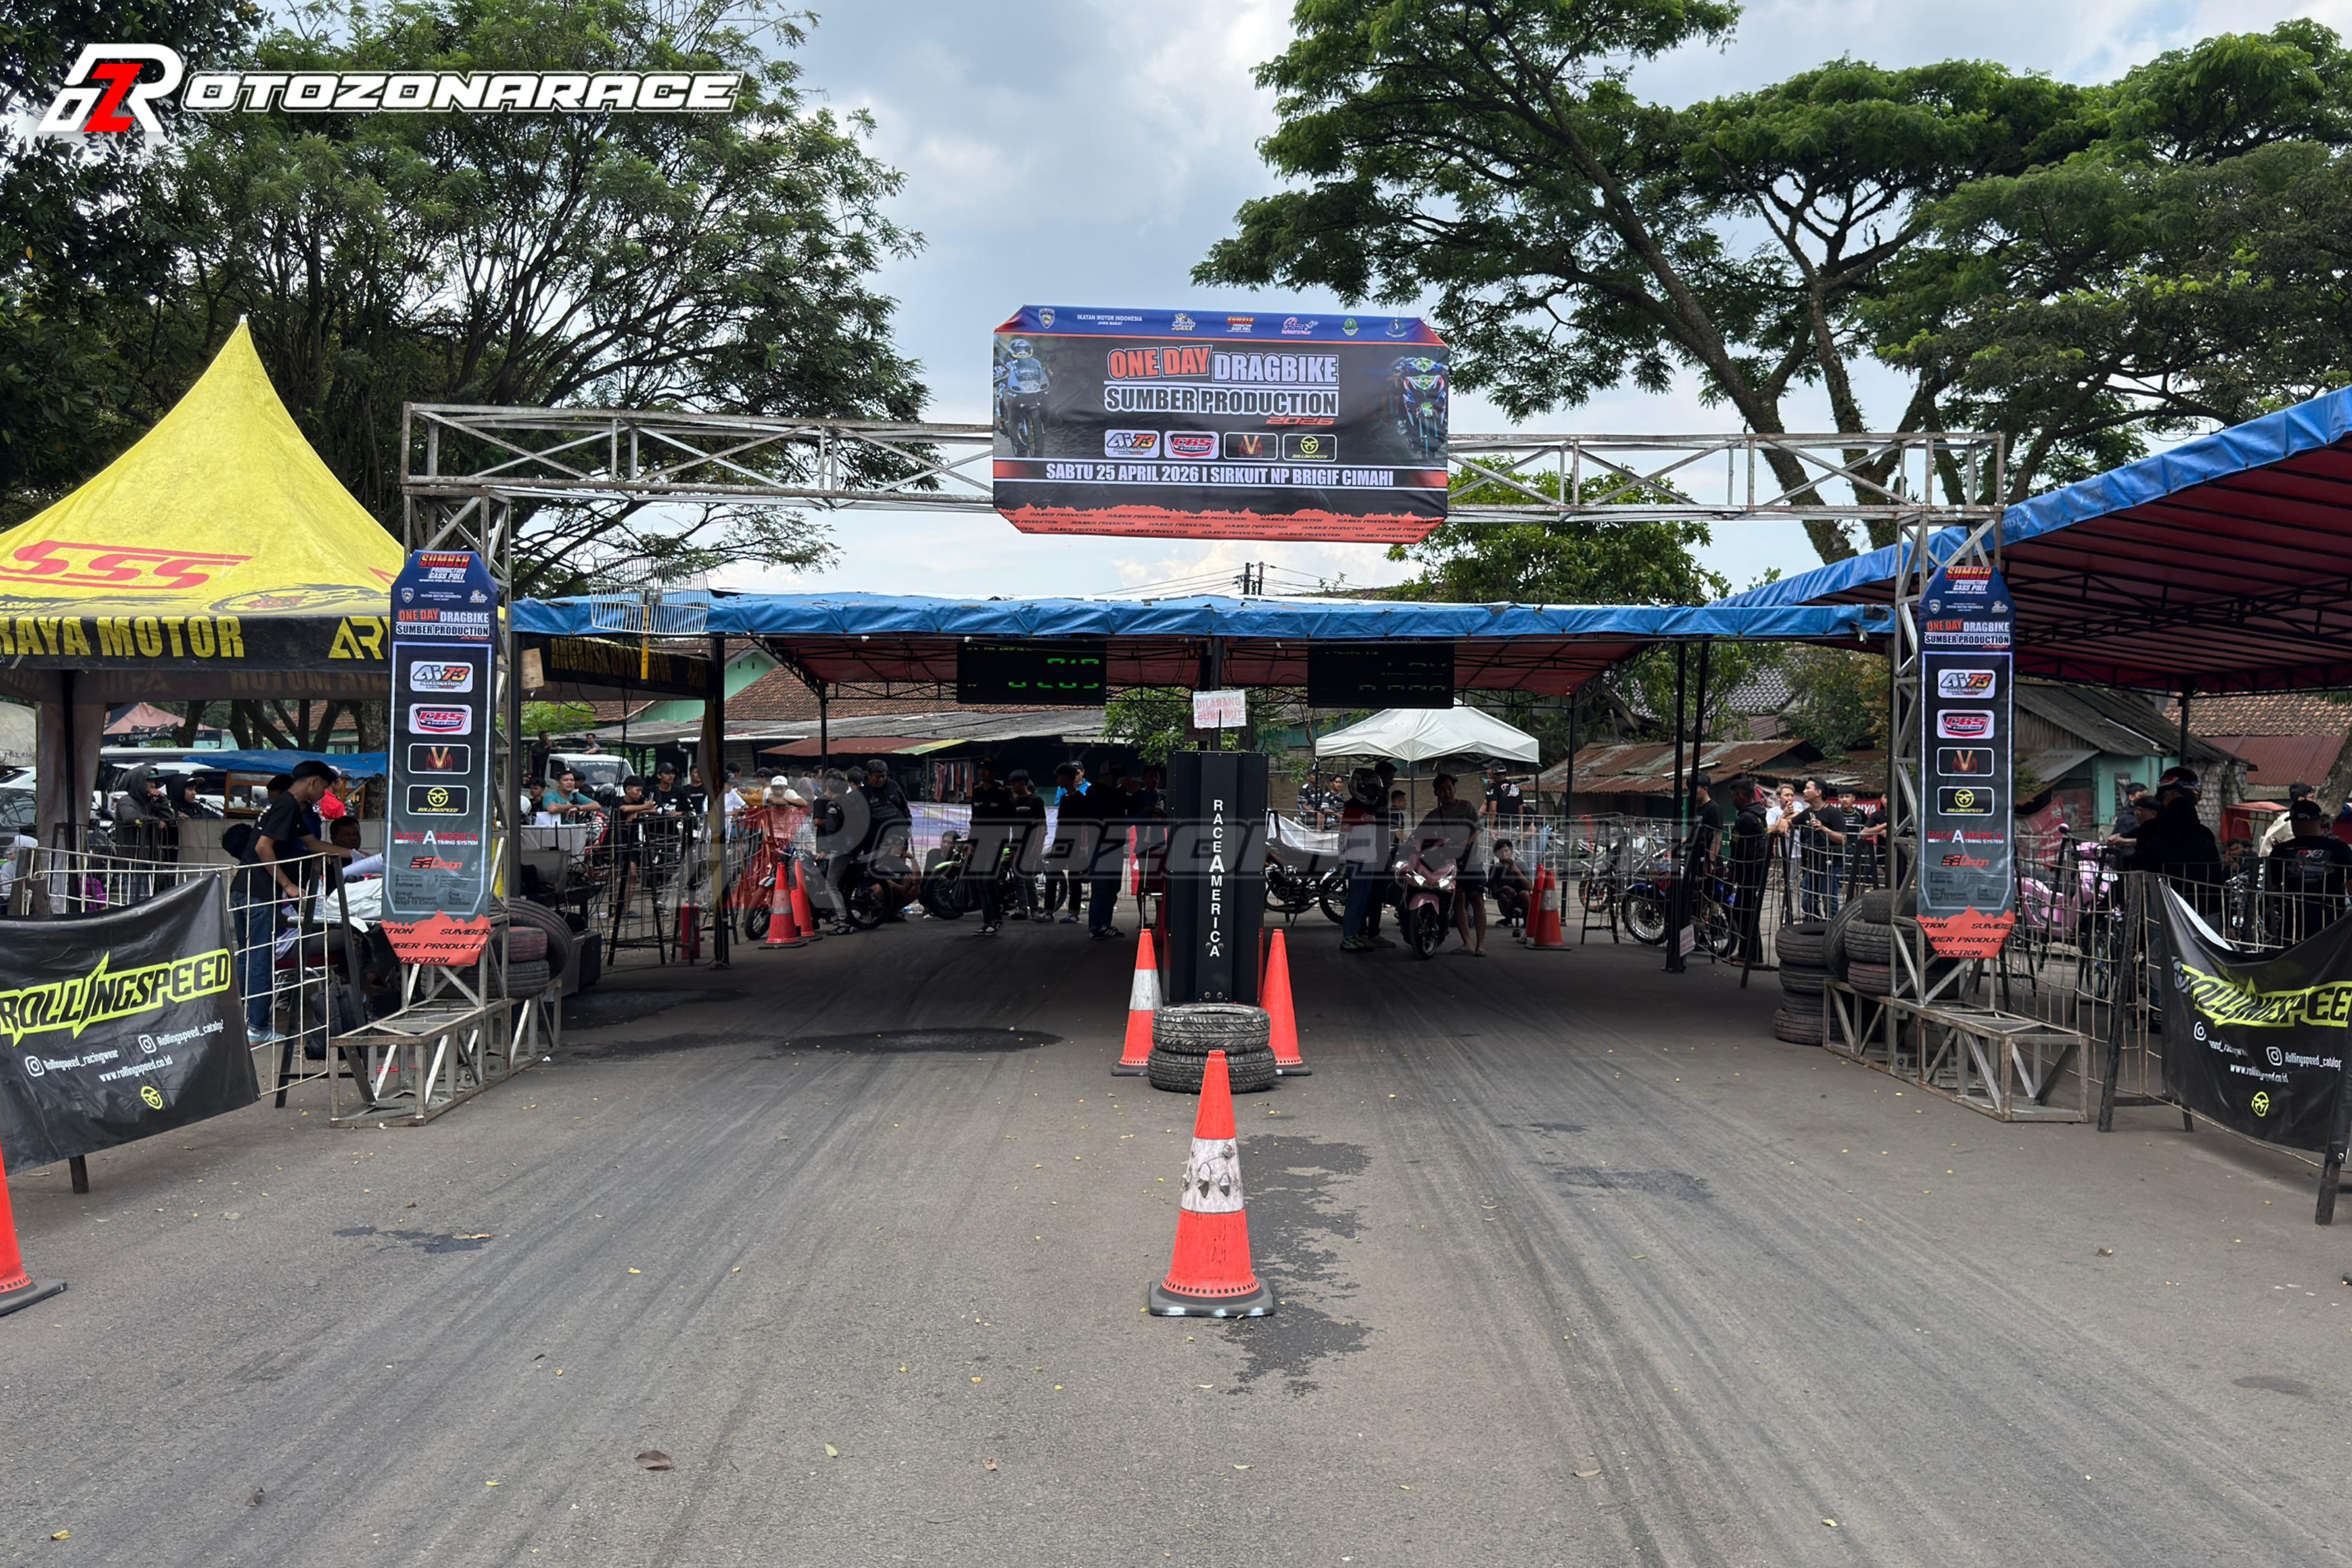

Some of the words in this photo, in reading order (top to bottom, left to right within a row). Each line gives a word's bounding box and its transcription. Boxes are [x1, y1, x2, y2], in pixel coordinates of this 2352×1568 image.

[1108, 348, 1160, 380] ONE
[1162, 346, 1211, 377] DAY
[1213, 353, 1339, 384] DRAGBIKE
[1104, 386, 1198, 412] SUMBER
[1199, 388, 1339, 416] PRODUCTION
[1266, 417, 1335, 425] 2026
[1046, 463, 1093, 480] SABTU
[1096, 464, 1115, 481] 25
[1119, 465, 1158, 482] APRIL
[1162, 466, 1198, 483] 2026
[1210, 468, 1268, 485] SIRKUIT
[1271, 469, 1289, 485] NP
[1293, 470, 1339, 486] BRIGIF
[1343, 471, 1393, 487] CIMAHI
[419, 553, 471, 568] SUMBER
[1945, 566, 1993, 580] SUMBER
[399, 610, 418, 621] ONE
[420, 609, 439, 620] DAY
[440, 611, 489, 624] DRAGBIKE
[396, 625, 434, 635] SUMBER
[434, 625, 489, 637] PRODUCTION
[1927, 620, 1944, 632] ONE
[1945, 620, 1962, 631] DAY
[1963, 622, 2009, 633] DRAGBIKE
[96, 615, 244, 658] MOTOR
[328, 616, 390, 659] AR
[1925, 634, 1957, 644] SUMBER
[1958, 634, 2010, 645] PRODUCTION
[1197, 697, 1240, 709] DILARANG
[0, 951, 231, 1045] ROLLINGSPEED
[99, 1055, 173, 1082] www.rollingspeed.co.id
